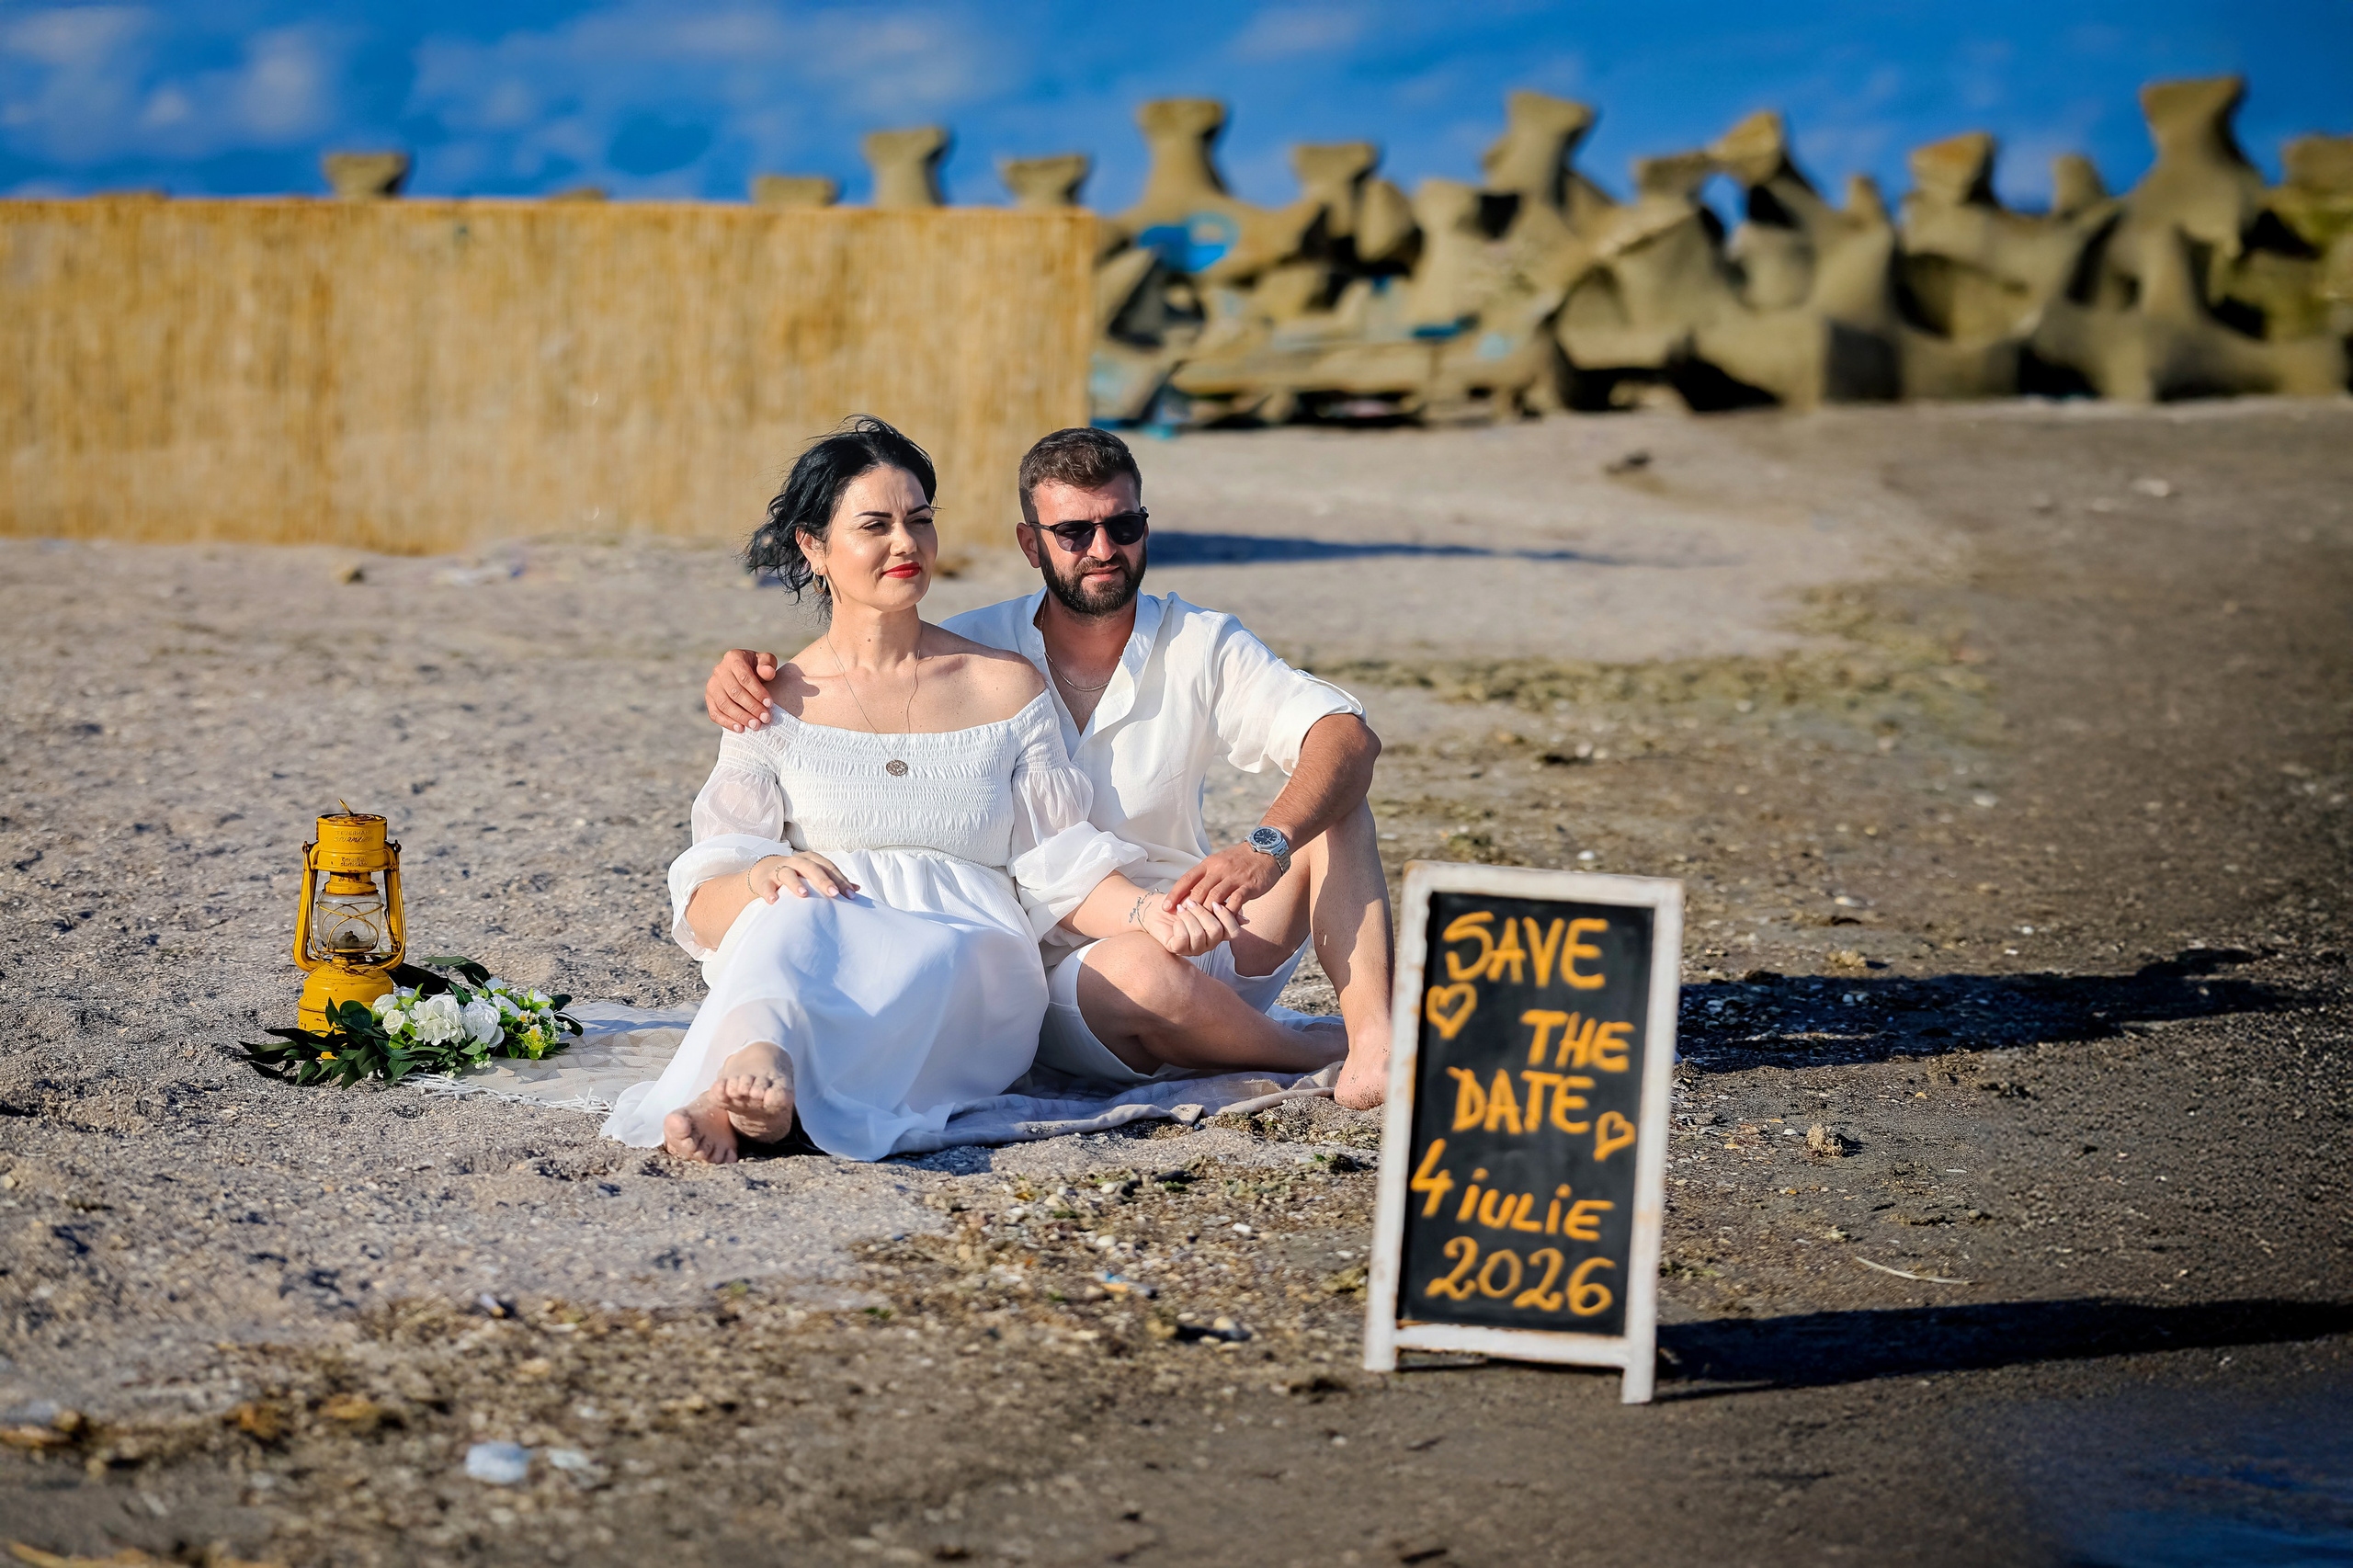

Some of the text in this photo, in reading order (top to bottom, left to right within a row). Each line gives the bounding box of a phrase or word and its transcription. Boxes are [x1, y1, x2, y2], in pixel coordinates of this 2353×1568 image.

[1441, 910, 1610, 990] SAVE
[1520, 1008, 1636, 1074] THE
[1446, 1065, 1596, 1136] DATE
[1410, 1137, 1455, 1219] 4
[1425, 1235, 1617, 1317] 2026
